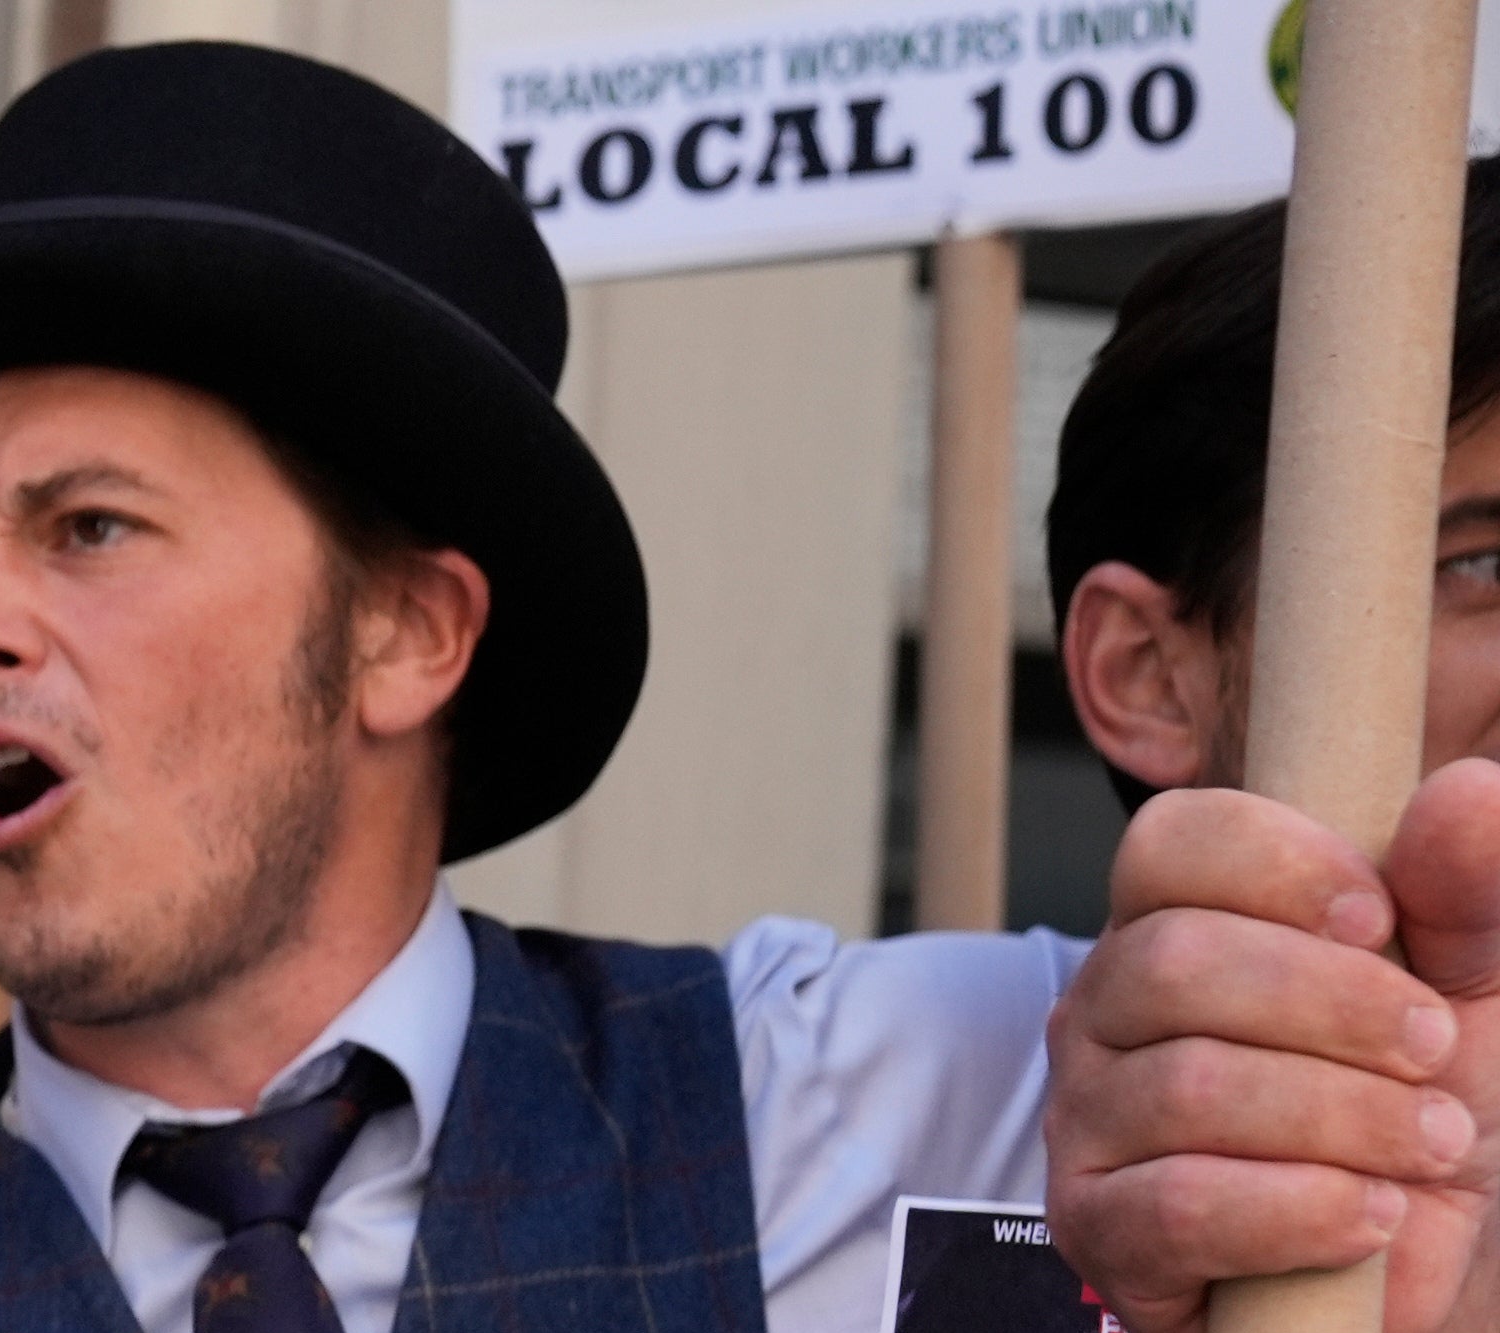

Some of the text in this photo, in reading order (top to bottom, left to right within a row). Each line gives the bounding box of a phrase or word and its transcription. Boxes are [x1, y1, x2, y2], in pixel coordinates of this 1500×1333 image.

[500, 0, 1199, 119] TRANSPORT WORKERS UNION
[499, 62, 1201, 212] LOCAL 100
